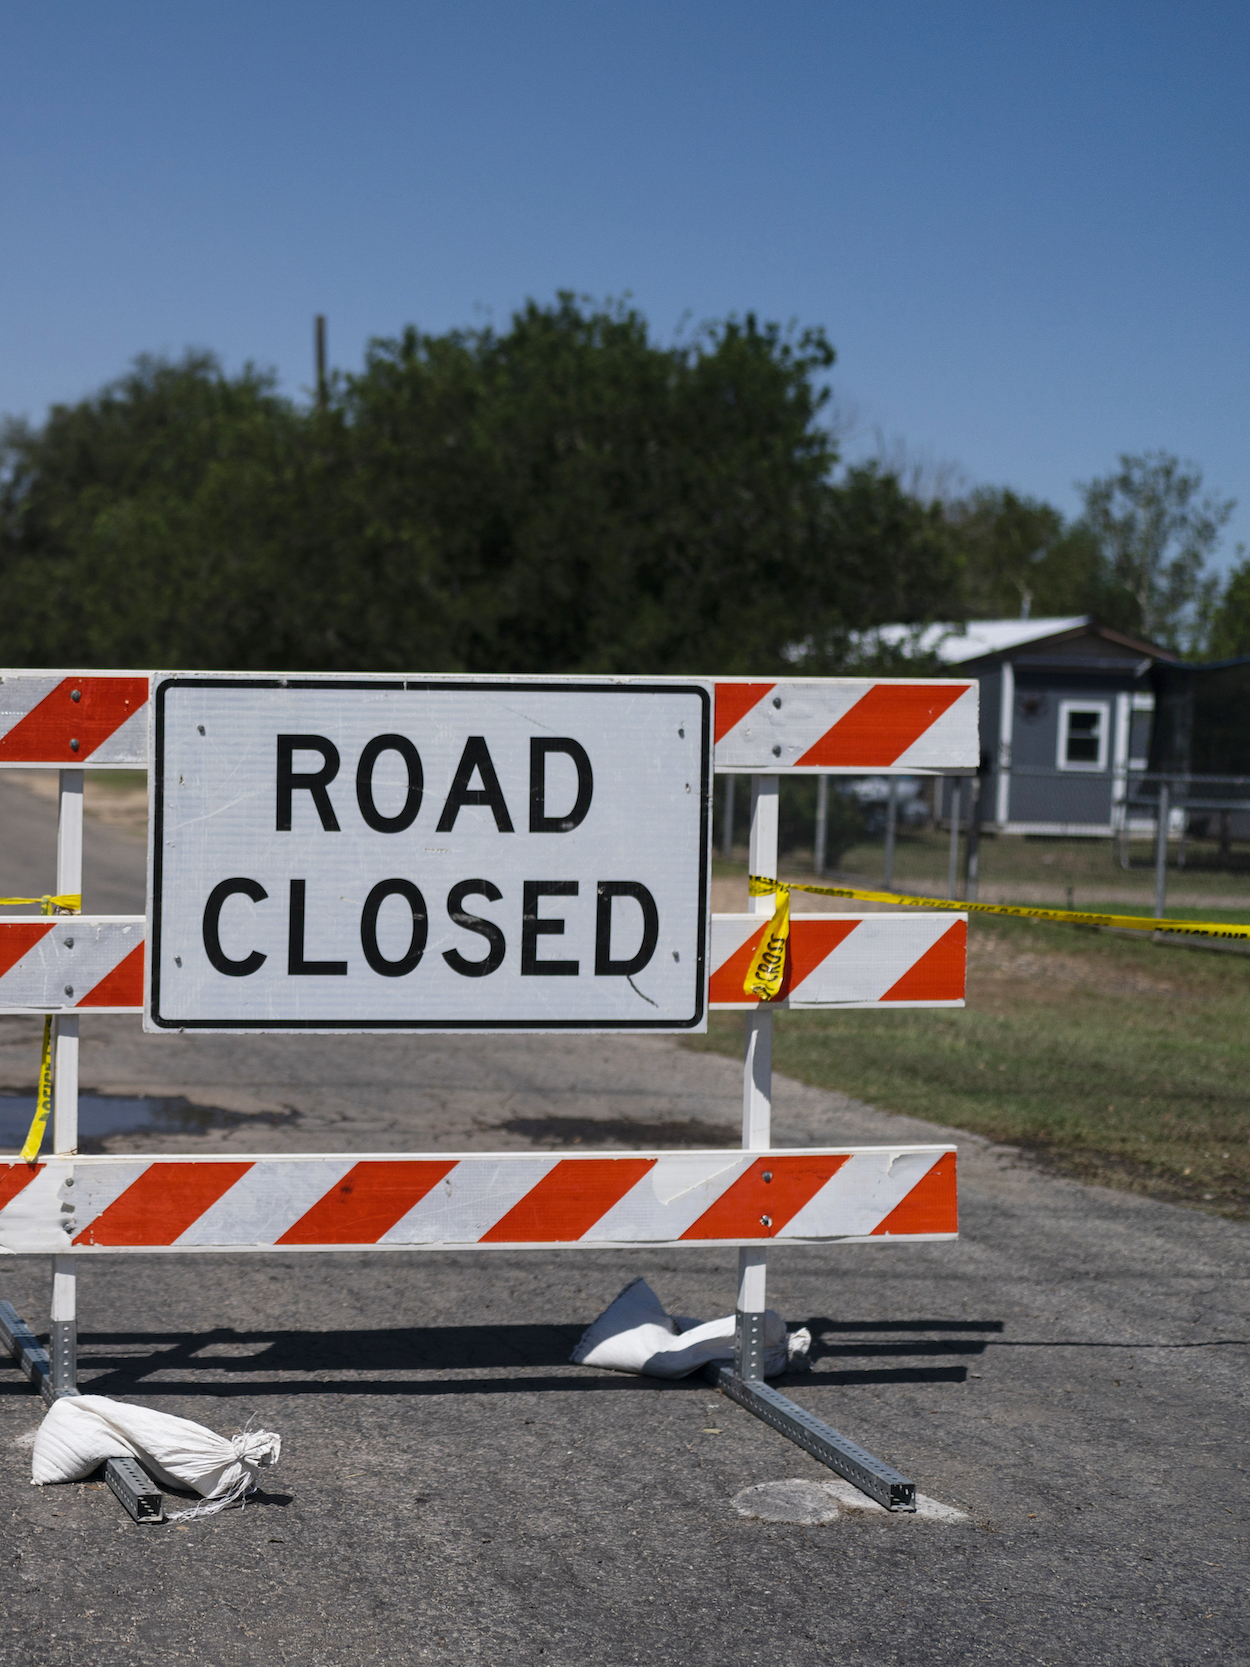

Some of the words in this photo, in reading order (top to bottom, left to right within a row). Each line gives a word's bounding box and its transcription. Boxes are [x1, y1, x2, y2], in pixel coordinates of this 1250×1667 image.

[275, 733, 594, 834] ROAD
[202, 877, 659, 978] CLOSED
[755, 932, 785, 983] CROSS
